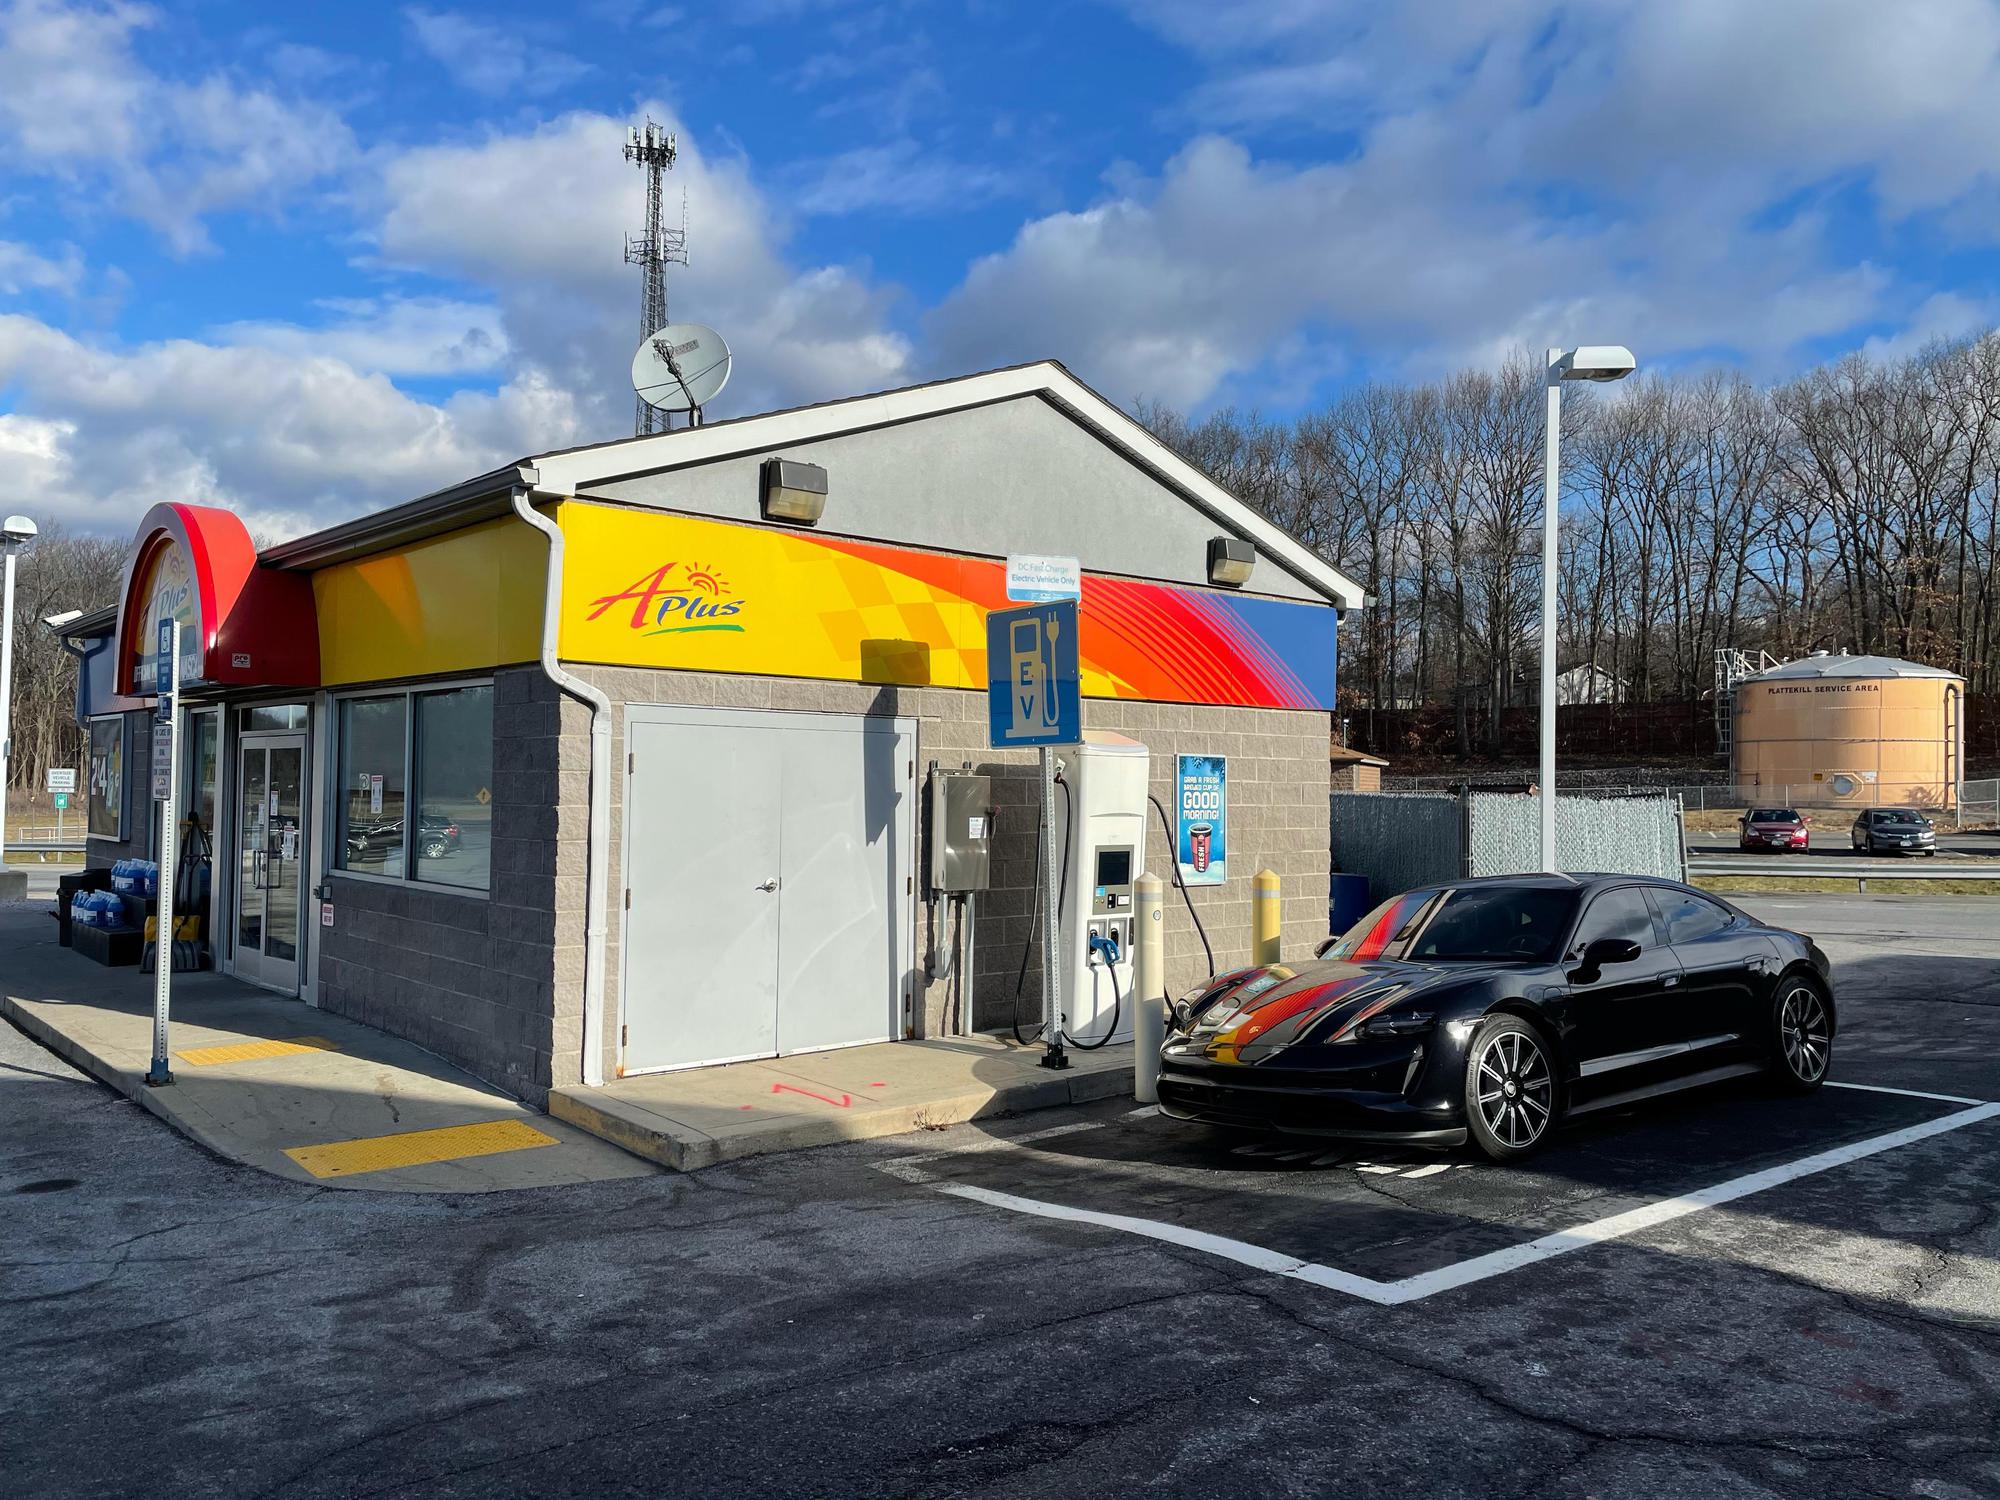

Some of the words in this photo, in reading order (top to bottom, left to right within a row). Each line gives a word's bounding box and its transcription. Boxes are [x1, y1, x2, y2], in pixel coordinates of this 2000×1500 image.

[1018, 562, 1029, 571] DC
[1012, 574, 1036, 583] Electric
[1037, 575, 1060, 584] Vehicle
[1060, 576, 1076, 586] Only
[1767, 686, 1812, 695] PLATTEKILL
[1815, 685, 1852, 693] SERVICE
[1855, 684, 1879, 692] AREA
[1203, 776, 1220, 784] FRESH
[1183, 791, 1220, 809] GOOD
[1183, 809, 1220, 820] MORNING!
